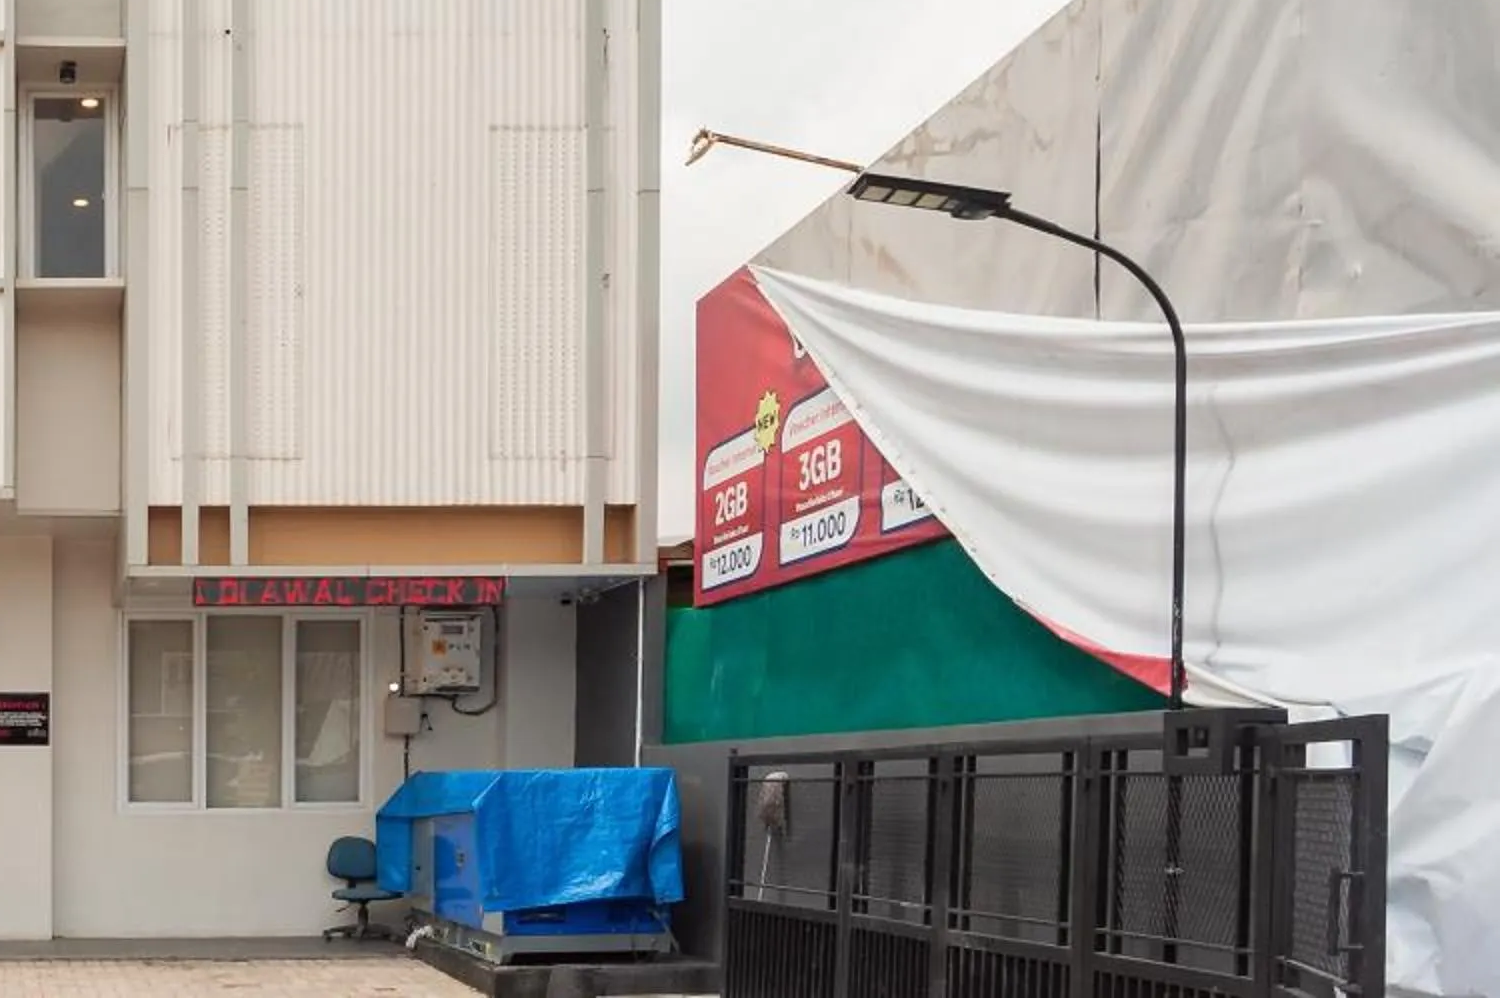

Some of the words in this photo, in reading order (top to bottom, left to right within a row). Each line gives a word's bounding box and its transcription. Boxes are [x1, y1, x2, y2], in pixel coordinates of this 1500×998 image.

[756, 412, 776, 432] NEW
[798, 439, 842, 491] 3GB
[714, 482, 748, 526] 2GB
[802, 511, 847, 548] 11.000
[717, 545, 753, 576] 12.000
[365, 578, 465, 604] CHECK
